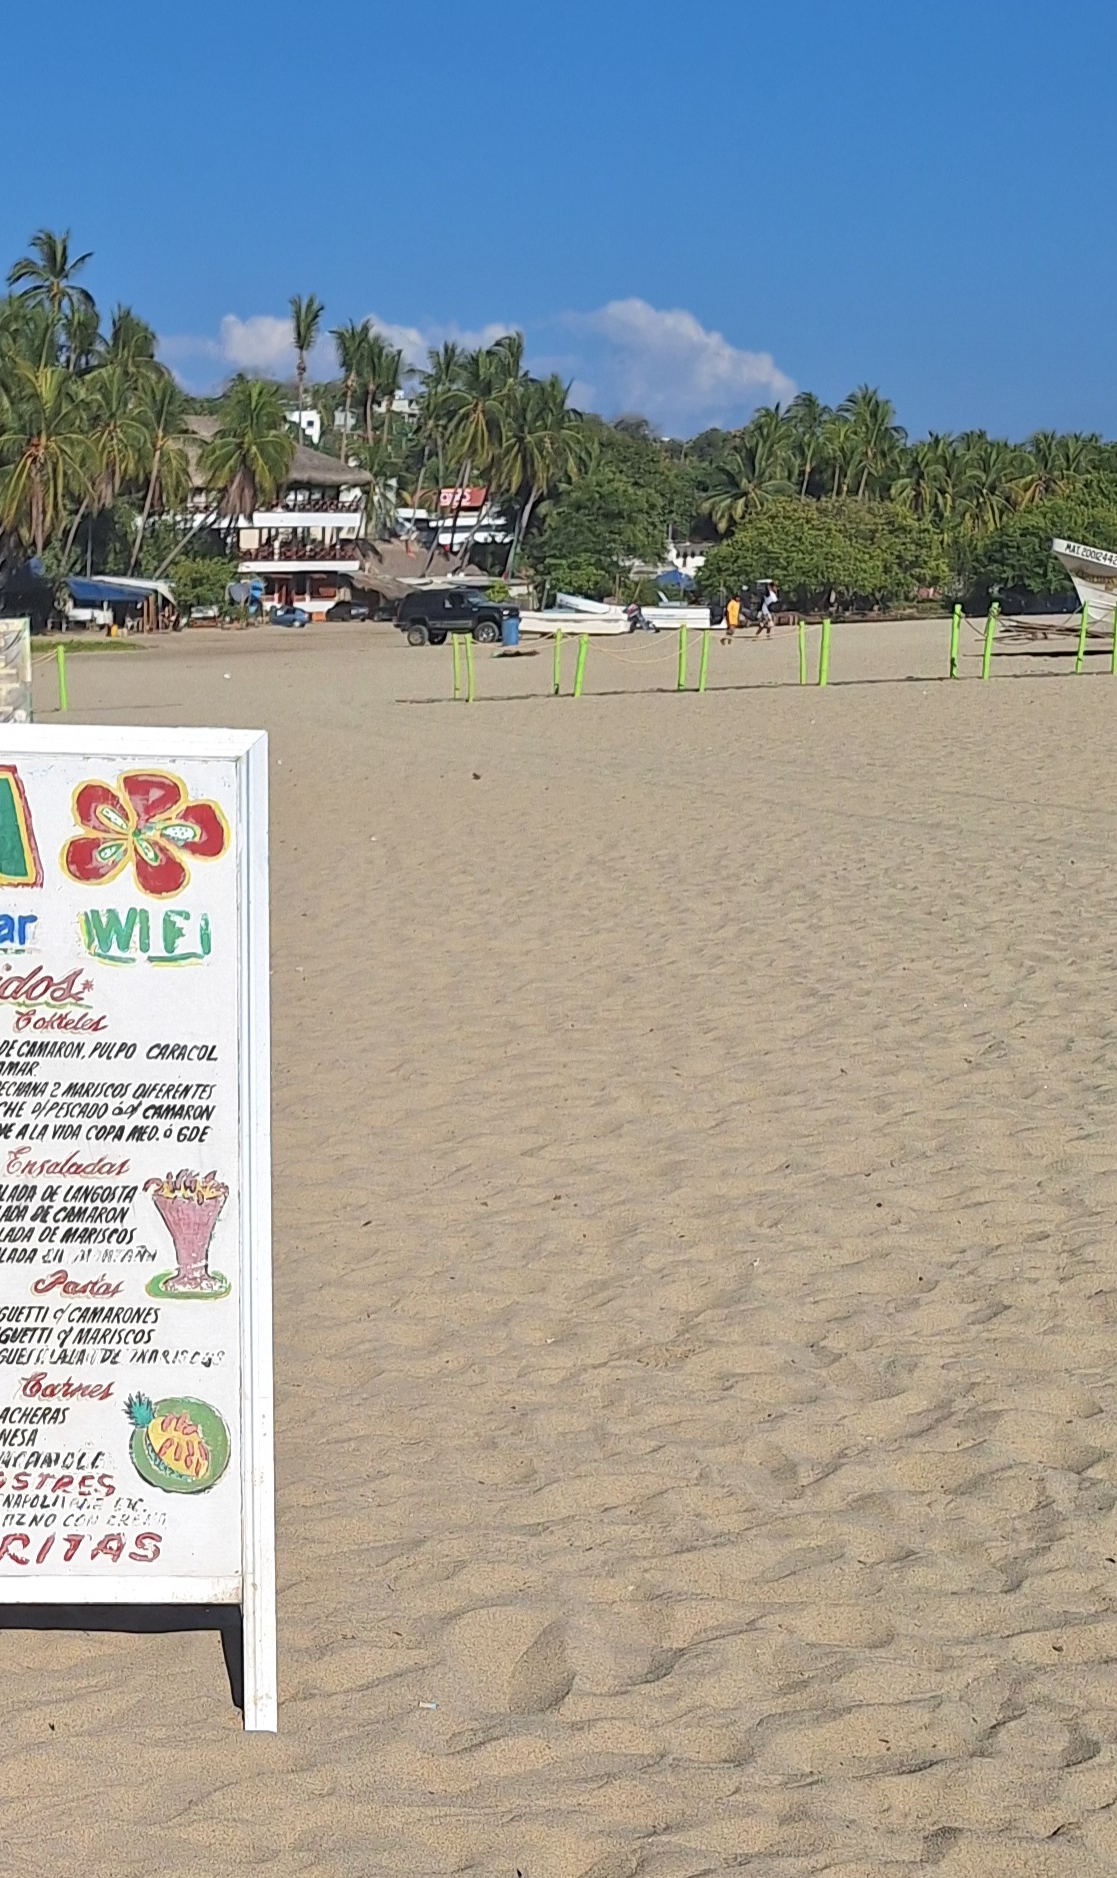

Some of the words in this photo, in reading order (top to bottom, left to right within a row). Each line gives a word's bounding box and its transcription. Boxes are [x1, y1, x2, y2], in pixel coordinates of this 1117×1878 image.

[88, 1042, 137, 1059] PULPO
[146, 1043, 218, 1061] CARACOL
[62, 1082, 132, 1098] MARISCOS
[132, 1082, 217, 1100] DIFERENTES
[142, 1103, 216, 1121] CAMARON
[50, 1124, 80, 1140] VIDA
[86, 1124, 122, 1142] COPA
[126, 1125, 159, 1142] MED.
[6, 1146, 130, 1175] Ensaladas
[41, 1185, 62, 1202] DE
[63, 1185, 138, 1203] LANGOSTA
[31, 1206, 53, 1223] DE
[53, 1207, 129, 1224] CAMARON
[39, 1227, 60, 1243] DE
[61, 1227, 136, 1245] MARISCOS
[33, 1270, 125, 1296] Pastas
[22, 1372, 115, 1400] Carnes
